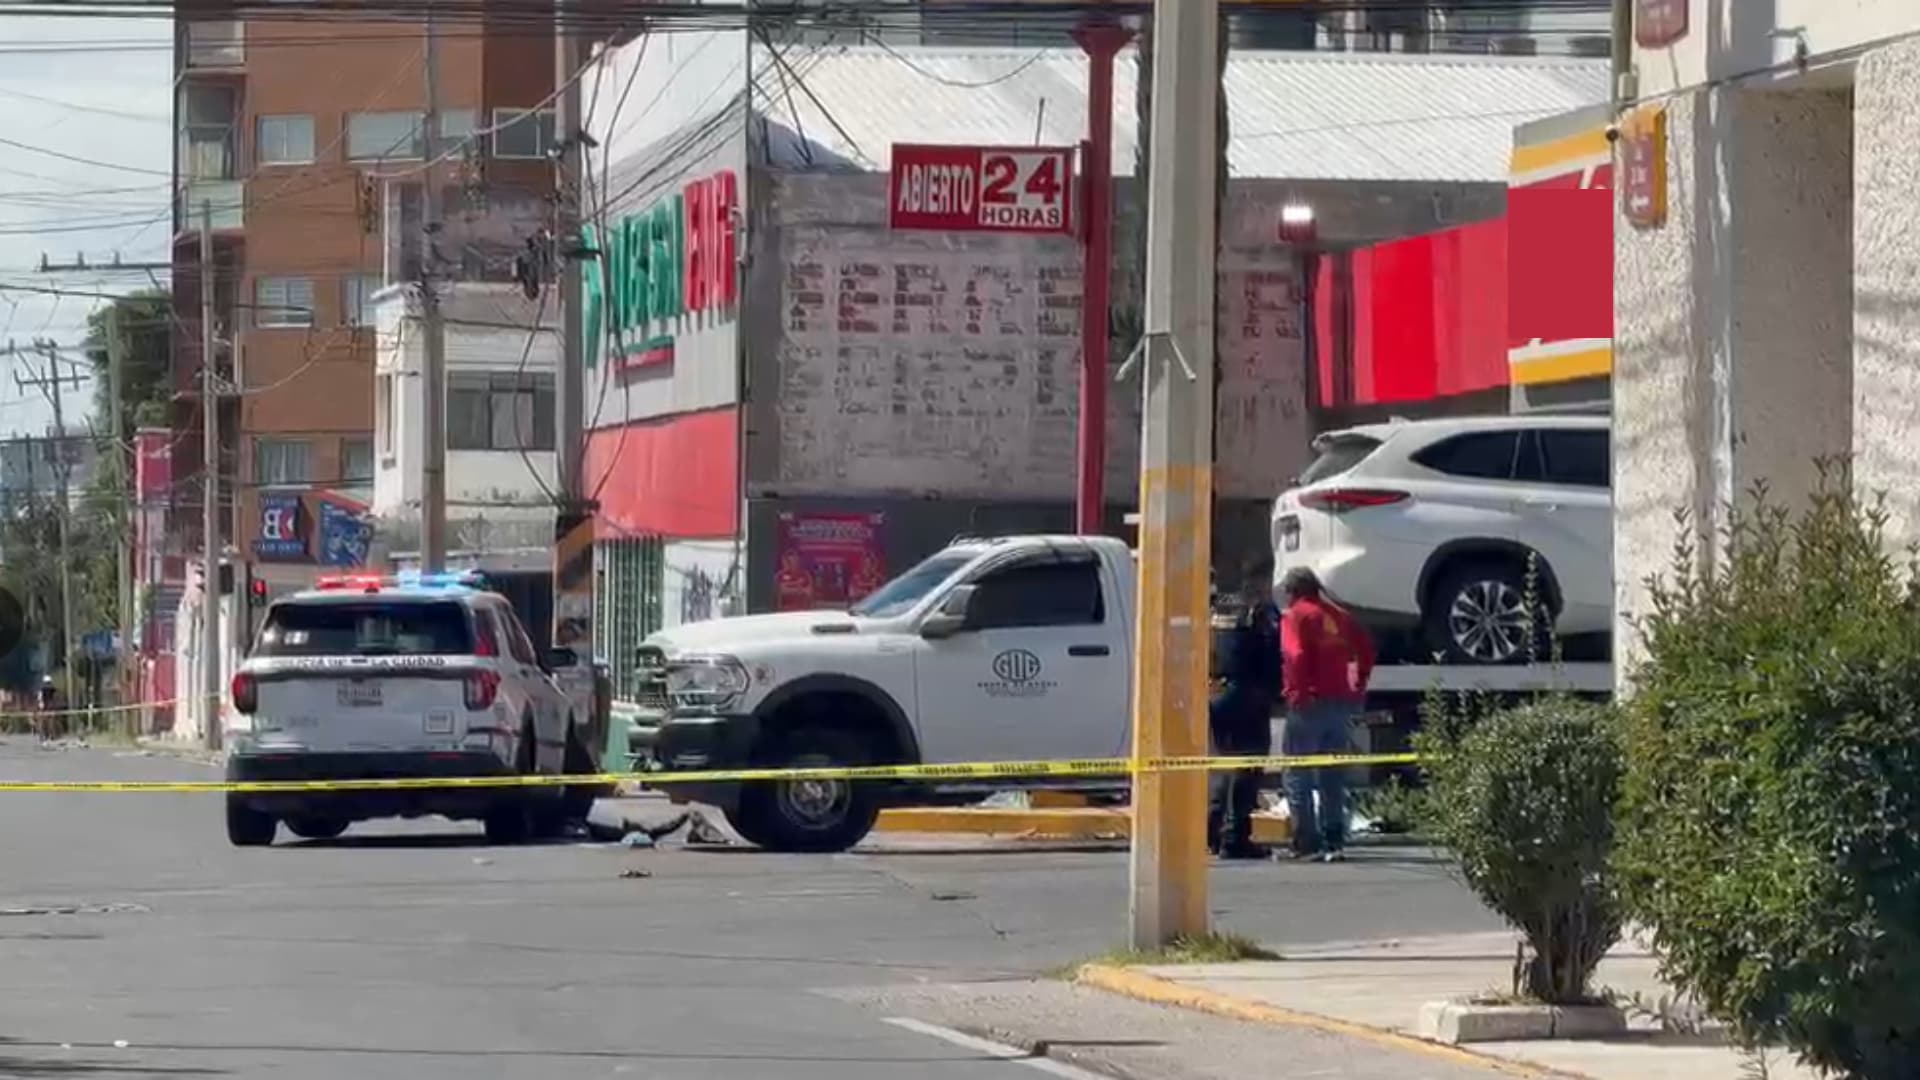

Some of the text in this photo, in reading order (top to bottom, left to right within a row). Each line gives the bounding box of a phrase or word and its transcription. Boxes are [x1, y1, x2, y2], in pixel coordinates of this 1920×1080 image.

[898, 155, 1061, 215] ABIERTO 24
[981, 206, 1060, 225] HORAS
[392, 656, 446, 667] CIUDAD
